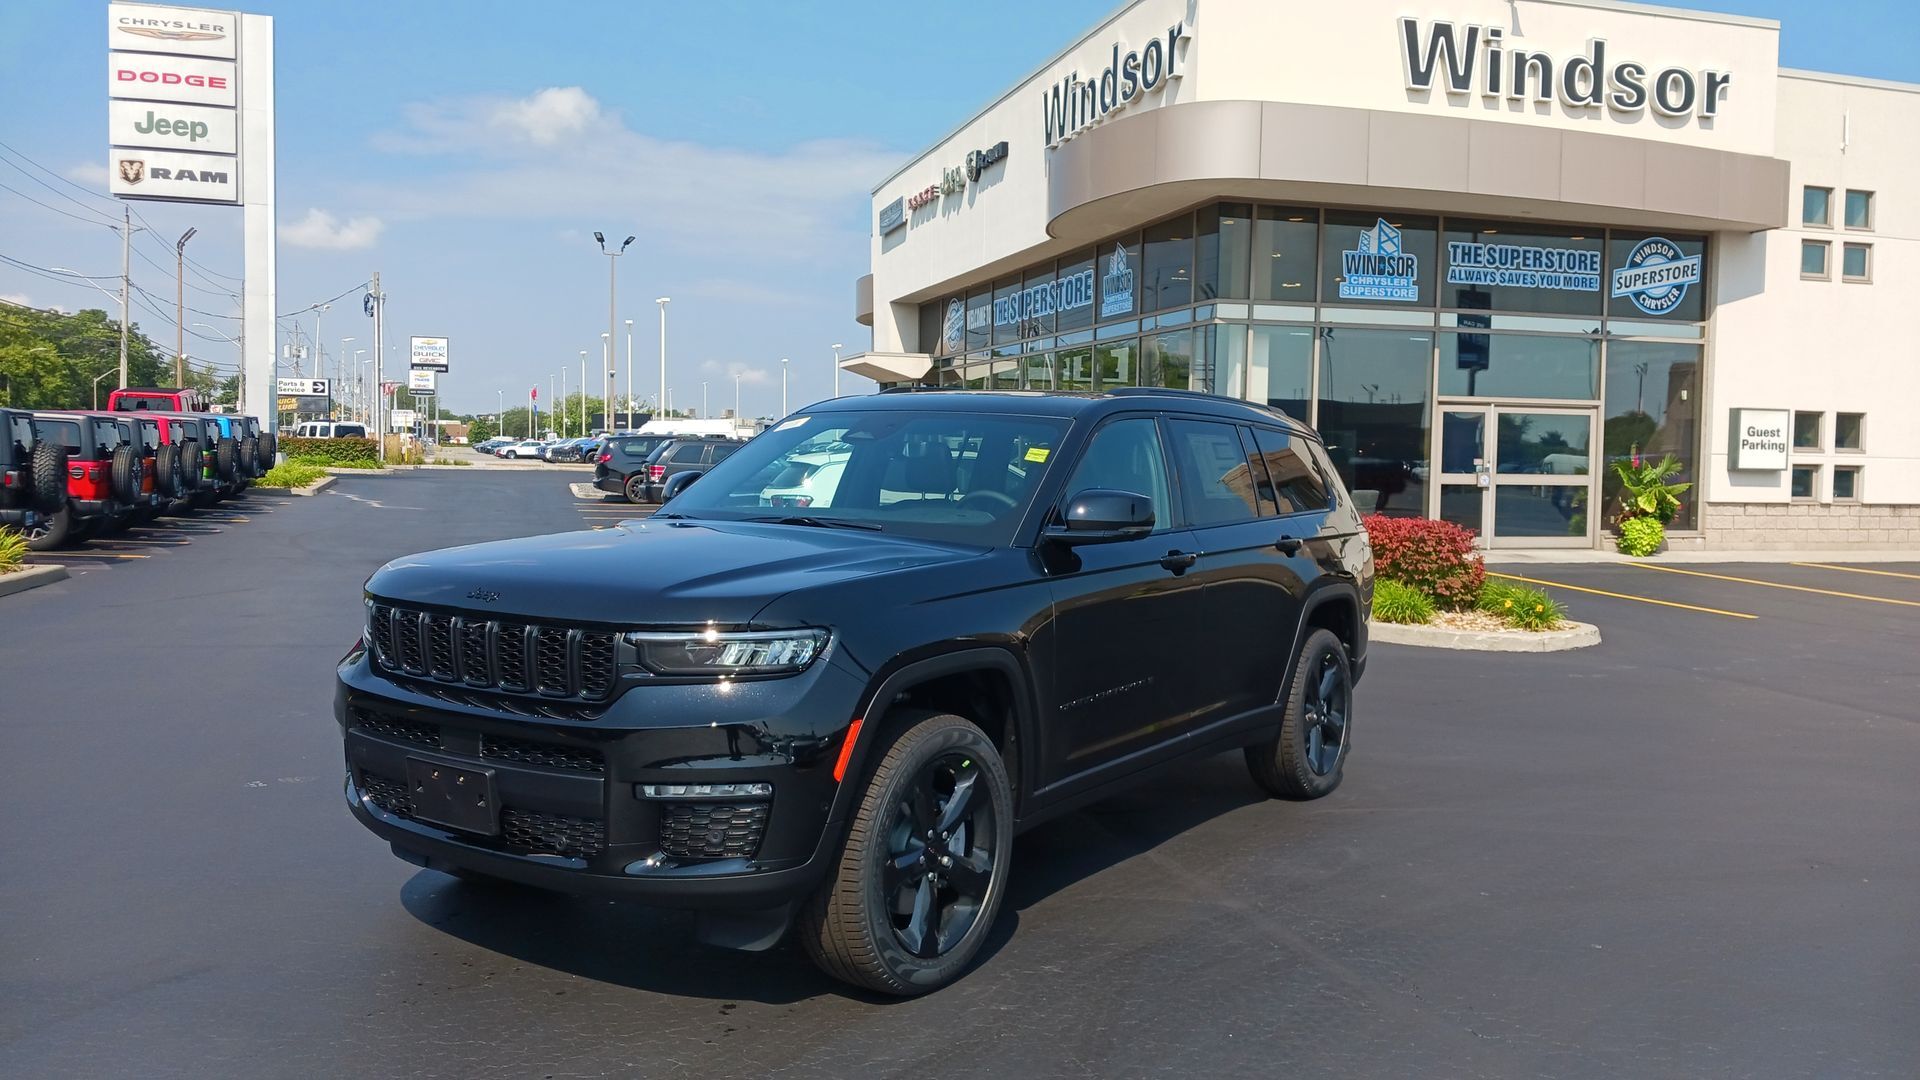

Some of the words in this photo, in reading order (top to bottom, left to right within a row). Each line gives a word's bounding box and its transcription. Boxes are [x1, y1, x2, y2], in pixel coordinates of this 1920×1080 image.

[119, 17, 225, 33] CHRYSLER
[1397, 17, 1732, 118] Windsor
[117, 69, 227, 90] DODGE
[1042, 20, 1192, 149] Windsor
[134, 111, 209, 142] Jeep
[150, 167, 228, 184] RAM
[1450, 244, 1483, 264] THE
[1486, 244, 1599, 272] SUPERSTORE
[1633, 243, 1675, 264] WINDSOR
[1345, 253, 1415, 278] WINDSOR
[1350, 276, 1408, 287] CHRYSLER
[1450, 270, 1496, 283] ALWAYS
[1500, 273, 1536, 286] SAVES
[1539, 275, 1561, 287] YOU
[1563, 277, 1598, 289] MORE!
[1616, 263, 1698, 290] SUPERSTORE
[994, 301, 1008, 325] THE
[1009, 271, 1094, 323] SUPERSTORE
[1343, 286, 1416, 298] SUPERSTORE
[1639, 287, 1681, 310] CHRYSLER
[1747, 426, 1781, 438] Guest
[1741, 439, 1786, 453] Parking
